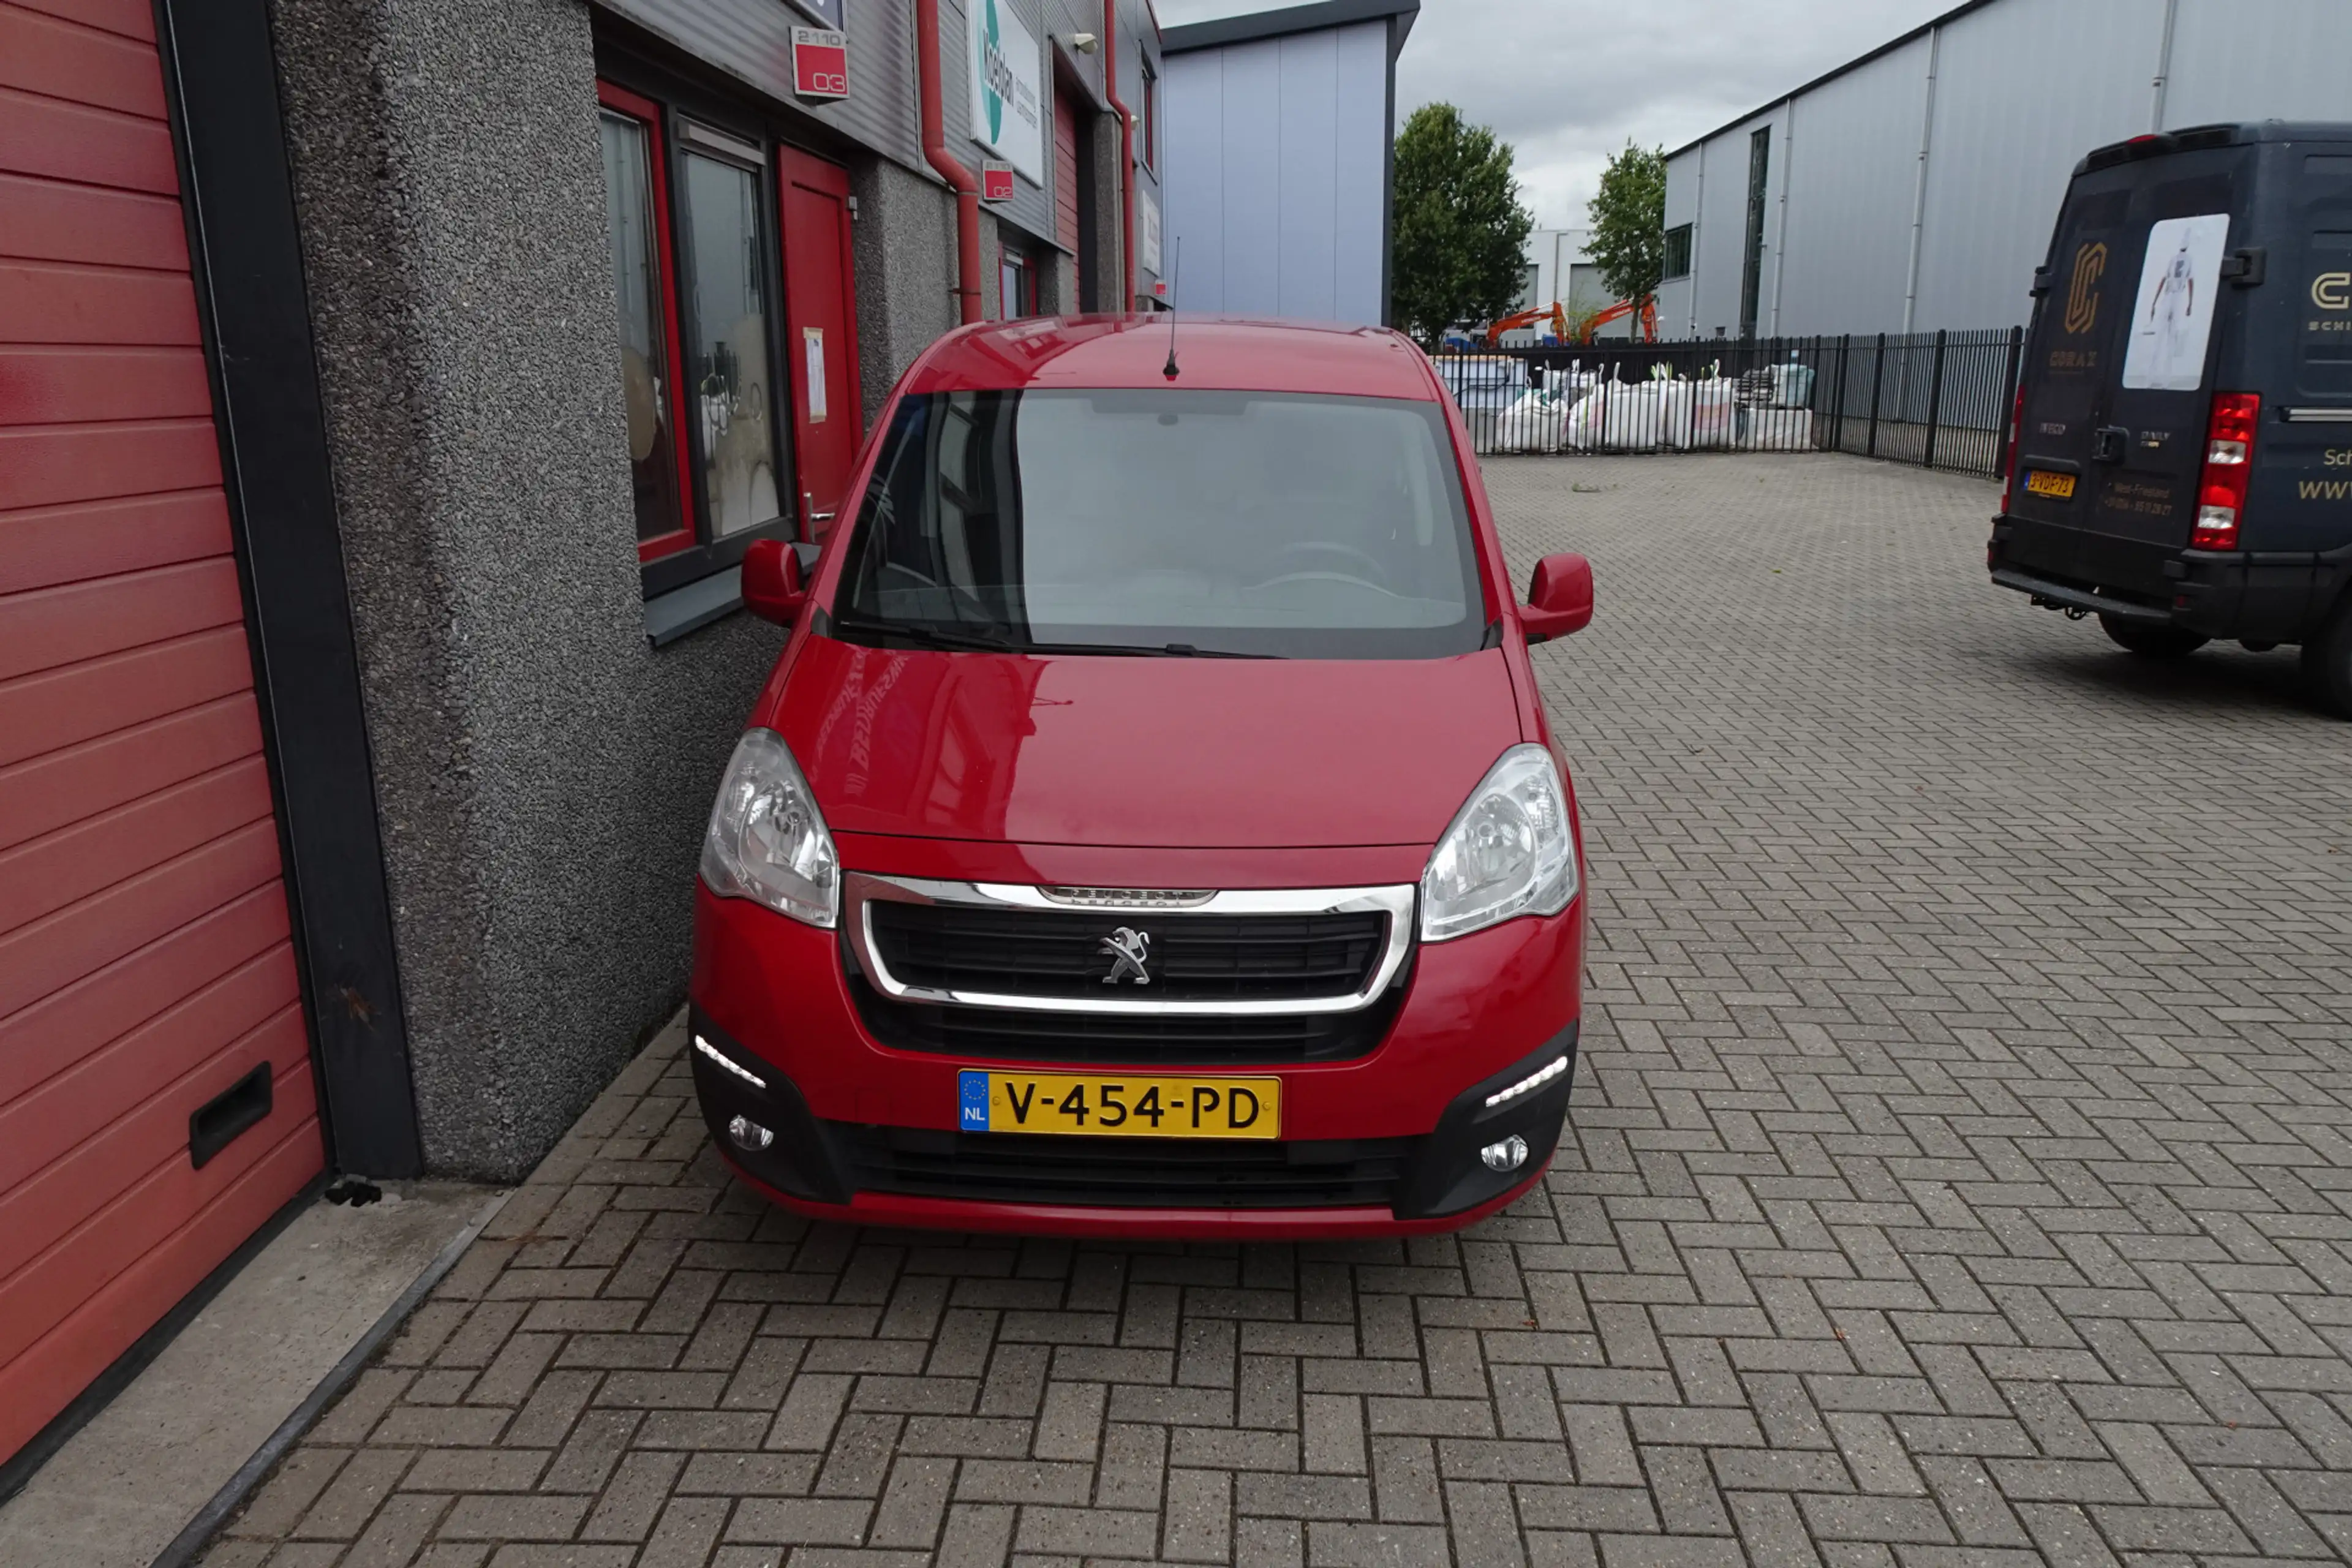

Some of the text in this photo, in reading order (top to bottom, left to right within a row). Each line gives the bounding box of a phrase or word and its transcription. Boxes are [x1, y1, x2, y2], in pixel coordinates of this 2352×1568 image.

[798, 31, 840, 46] 2110
[813, 73, 845, 92] 03
[994, 186, 1012, 198] 02
[1005, 1081, 1259, 1129] V-454-PD
[965, 1107, 985, 1121] NL
